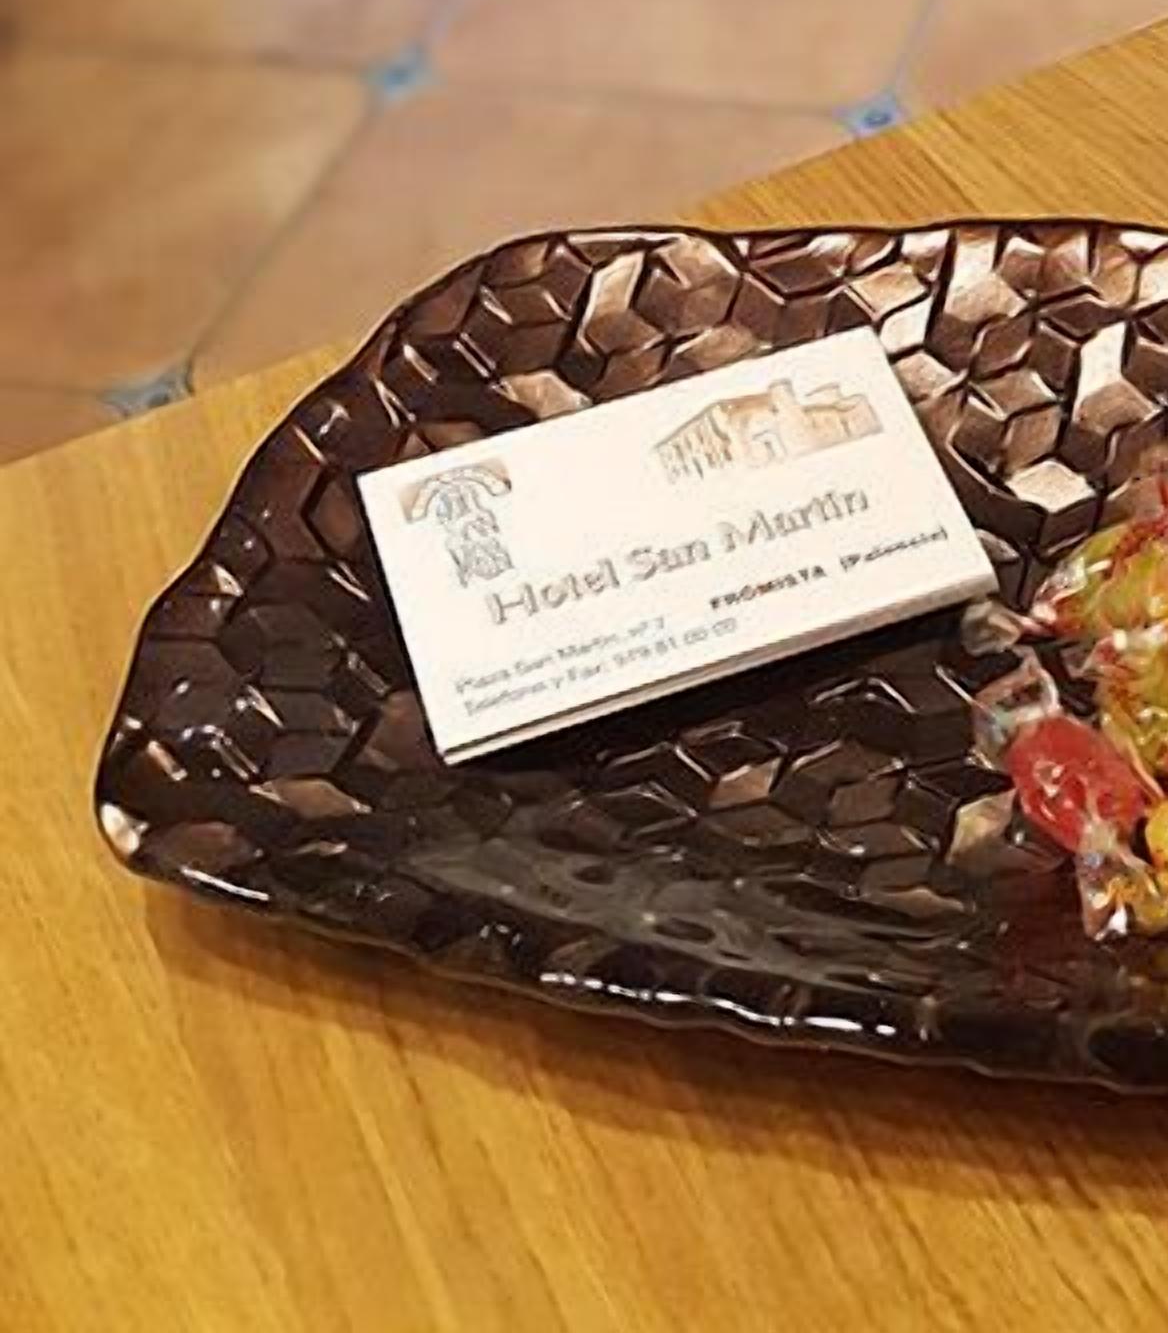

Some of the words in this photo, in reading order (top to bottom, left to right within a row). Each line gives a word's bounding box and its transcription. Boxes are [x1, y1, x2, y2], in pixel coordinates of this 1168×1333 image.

[485, 558, 620, 625] Hotel
[625, 538, 711, 581] San
[514, 656, 552, 676] San
